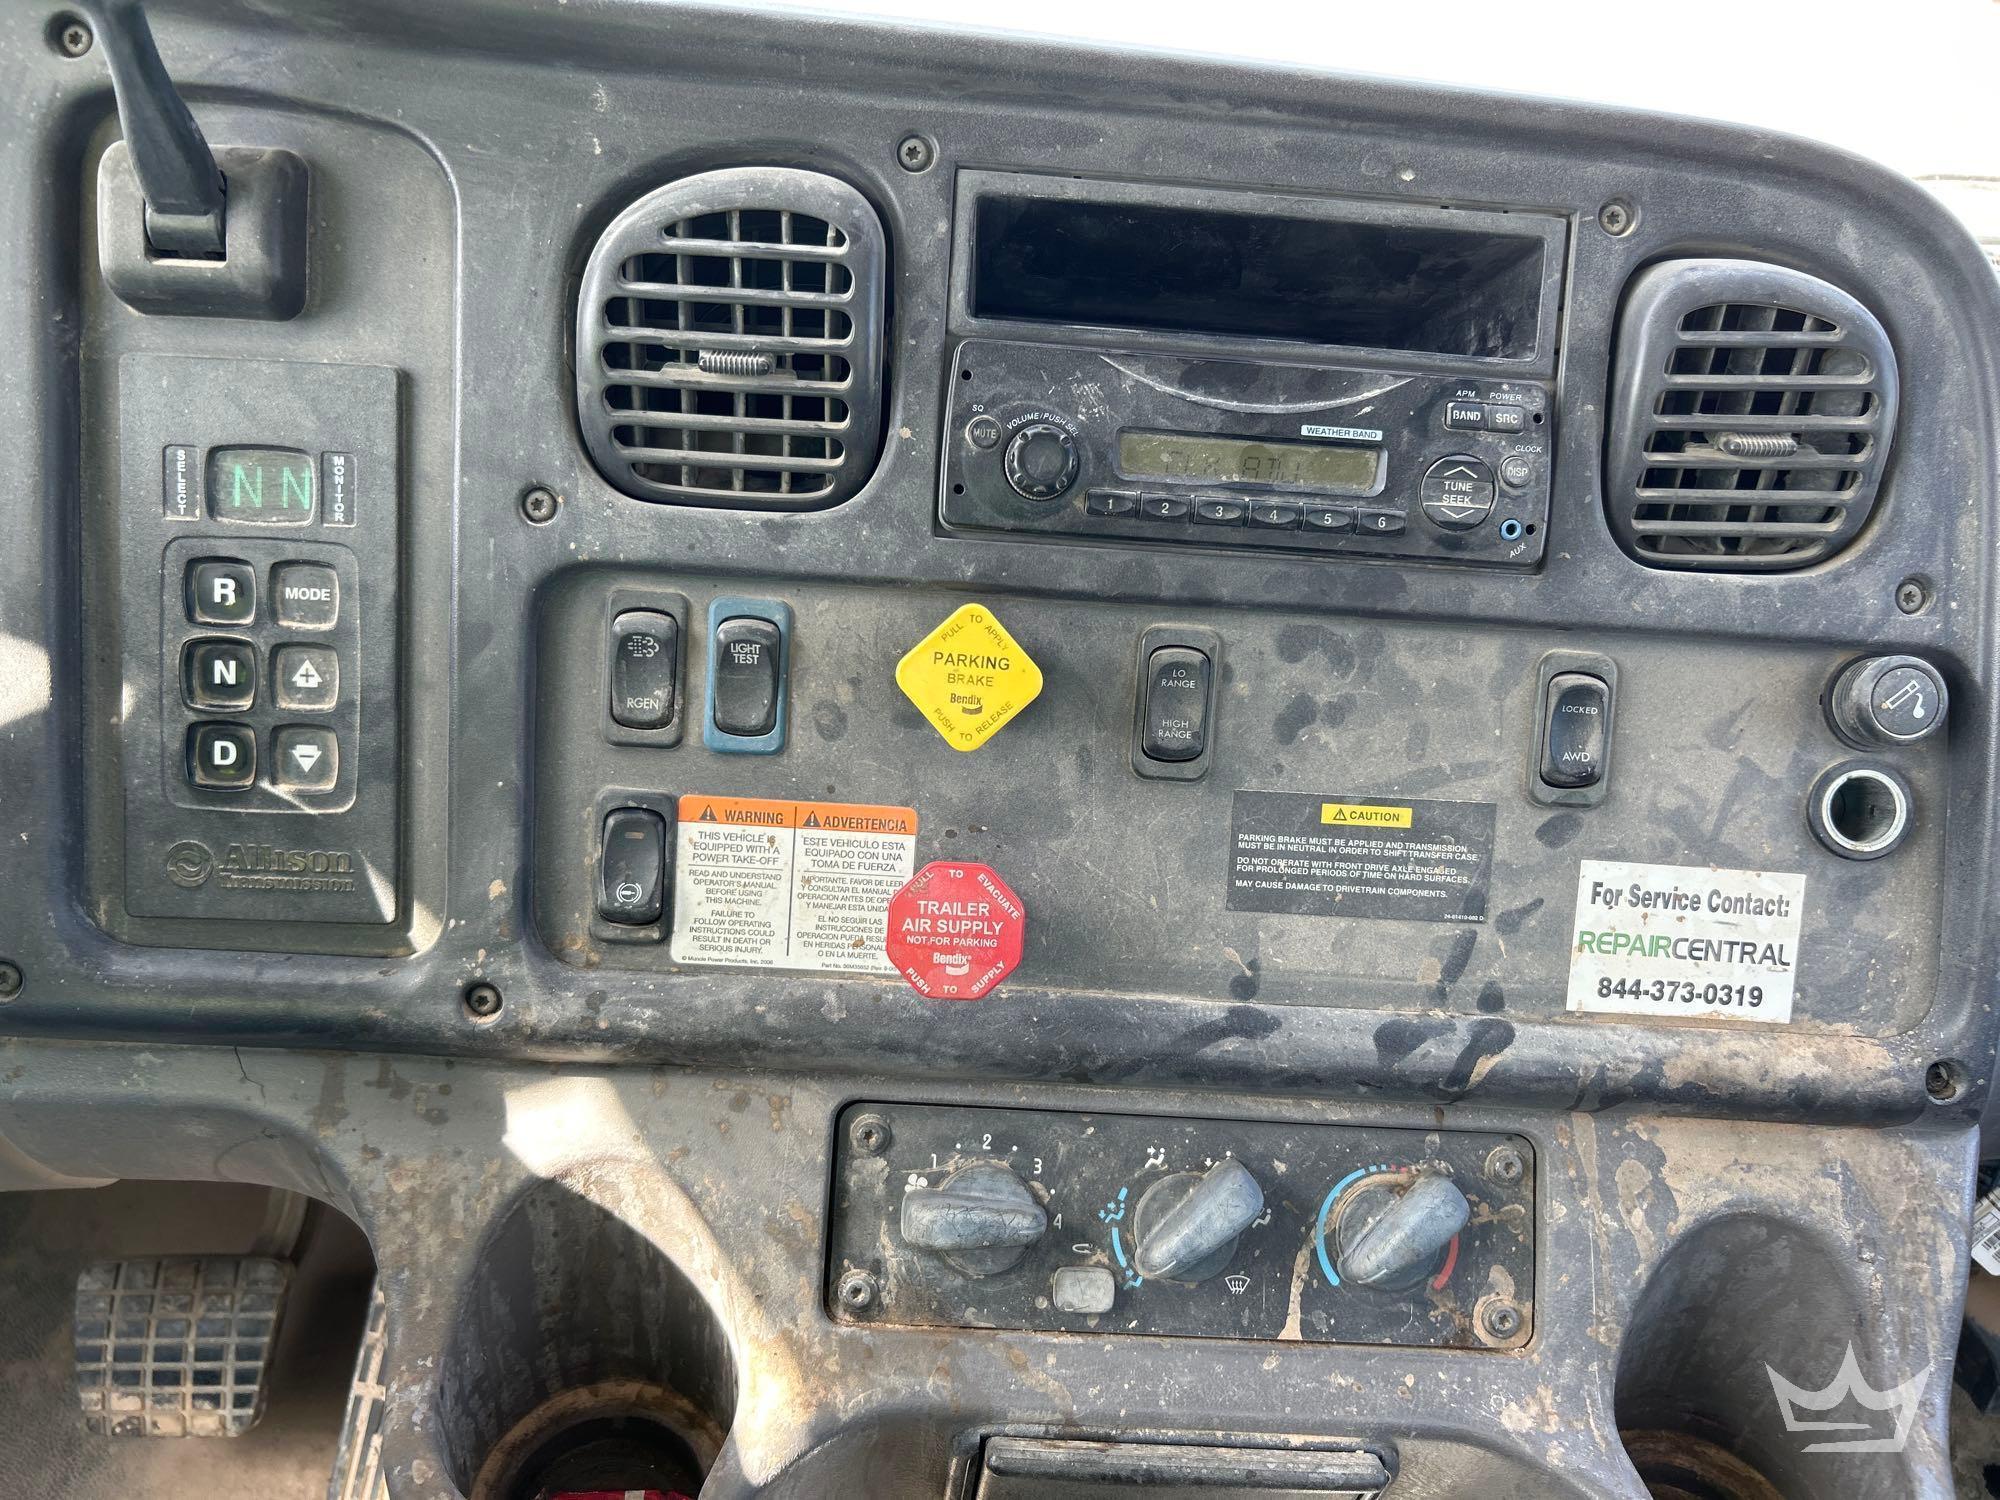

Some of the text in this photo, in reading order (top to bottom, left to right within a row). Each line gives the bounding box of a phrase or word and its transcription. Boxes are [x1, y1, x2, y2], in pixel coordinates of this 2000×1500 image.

[1456, 390, 1475, 398] APM
[1489, 392, 1522, 401] POWER
[1452, 410, 1481, 422] BAND
[1496, 413, 1518, 424] SRC
[973, 428, 996, 438] MUTE
[1065, 423, 1079, 437] SEL
[1307, 427, 1377, 439] WEATHER BAND
[1515, 444, 1542, 454] CLOCK
[1507, 466, 1528, 477] DISP
[176, 449, 187, 516] SELECT
[232, 464, 312, 511] N N
[333, 455, 345, 522] MONITOR
[1444, 481, 1473, 493] TUNE
[1108, 500, 1113, 509] 1
[1442, 494, 1471, 505] SEEK
[1162, 503, 1169, 513] 2
[1216, 506, 1223, 516] 3
[1269, 511, 1277, 522] 4
[1324, 514, 1332, 525] 5
[1378, 517, 1386, 528] 6
[1509, 542, 1526, 559] AUX
[213, 577, 236, 605] R
[285, 586, 331, 601] MODE
[941, 614, 1009, 651] PULL TO APPLY
[731, 643, 761, 654] LIGHT
[733, 653, 759, 665] TEST
[933, 652, 1010, 671] PARKING
[213, 660, 236, 685] N
[1173, 669, 1186, 678] LO
[948, 673, 994, 687] BRAKE
[1162, 679, 1196, 689] RANGE
[627, 697, 659, 710] RGEN
[950, 693, 982, 705] Bendix
[1562, 706, 1598, 714] LOCKED
[934, 701, 1014, 742] PUSH TO RELEASE
[1163, 720, 1189, 728] HIGH
[1159, 731, 1192, 739] RANGE
[213, 741, 236, 766] D
[1563, 752, 1590, 762] AWD
[725, 809, 784, 824] WARNING
[1350, 810, 1400, 822] CAUTION
[823, 816, 907, 832] ADVERTENCIA
[698, 831, 720, 840] THIS
[723, 833, 764, 843] VEHICLE
[1239, 834, 1275, 842] PARKING
[1278, 836, 1307, 844] BRAKE
[1309, 837, 1332, 845] MUST
[1349, 840, 1383, 848] APPLIED
[1405, 842, 1467, 852] TRANSMISSION
[693, 842, 743, 852] EQUIPPED
[746, 845, 770, 854] WITH
[803, 837, 905, 851] ESTE VEHICULO ESTA
[218, 843, 354, 873] Allison
[805, 848, 902, 861] EQUIPADO CON UNA
[1288, 845, 1326, 853] NEUTRAL
[1339, 847, 1368, 855] ORDER
[1409, 851, 1453, 859] TRANSFER
[693, 853, 779, 865] POWER TAKE-OFF
[1271, 859, 1309, 868] OPERATE
[1334, 861, 1362, 870] FRONT
[811, 859, 896, 872] TOMA DE FUERZA
[729, 872, 781, 880] UNDERSTAND
[1256, 865, 1308, 875] PROLONGED
[1311, 869, 1347, 877] PERIODS
[1350, 870, 1361, 878] OF
[1399, 873, 1422, 881] HARD
[693, 879, 742, 887] OPERATOR'S
[1255, 881, 1283, 889] CAUSE
[1286, 883, 1320, 891] DAMAGE
[1336, 885, 1385, 895] DRIVETRAIN
[706, 888, 737, 896] BEFORE
[949, 870, 964, 878] TO
[977, 873, 1021, 920] EVACUATE
[1590, 881, 1790, 917] For Service Contact:
[711, 910, 742, 918] FAILURE
[917, 901, 990, 916] TRAILER
[694, 918, 771, 928] FOLLOW OPERATING
[902, 918, 1004, 935] AIR SUPPLY
[689, 926, 775, 937] INSTRUCTIONS COULD
[906, 936, 998, 947] NOT FOR PARKING
[699, 944, 733, 952] SERIOUS
[1578, 930, 1791, 967] REPAIRCENTRAL
[906, 967, 931, 994] PUSH
[943, 985, 958, 994] TO
[971, 961, 1005, 993] SUPPLY
[1597, 977, 1763, 1008] 844-373-0319
[982, 1134, 992, 1150] 2
[931, 1153, 937, 1168] 1
[1033, 1158, 1042, 1174] 3
[1053, 1214, 1062, 1230] 4
